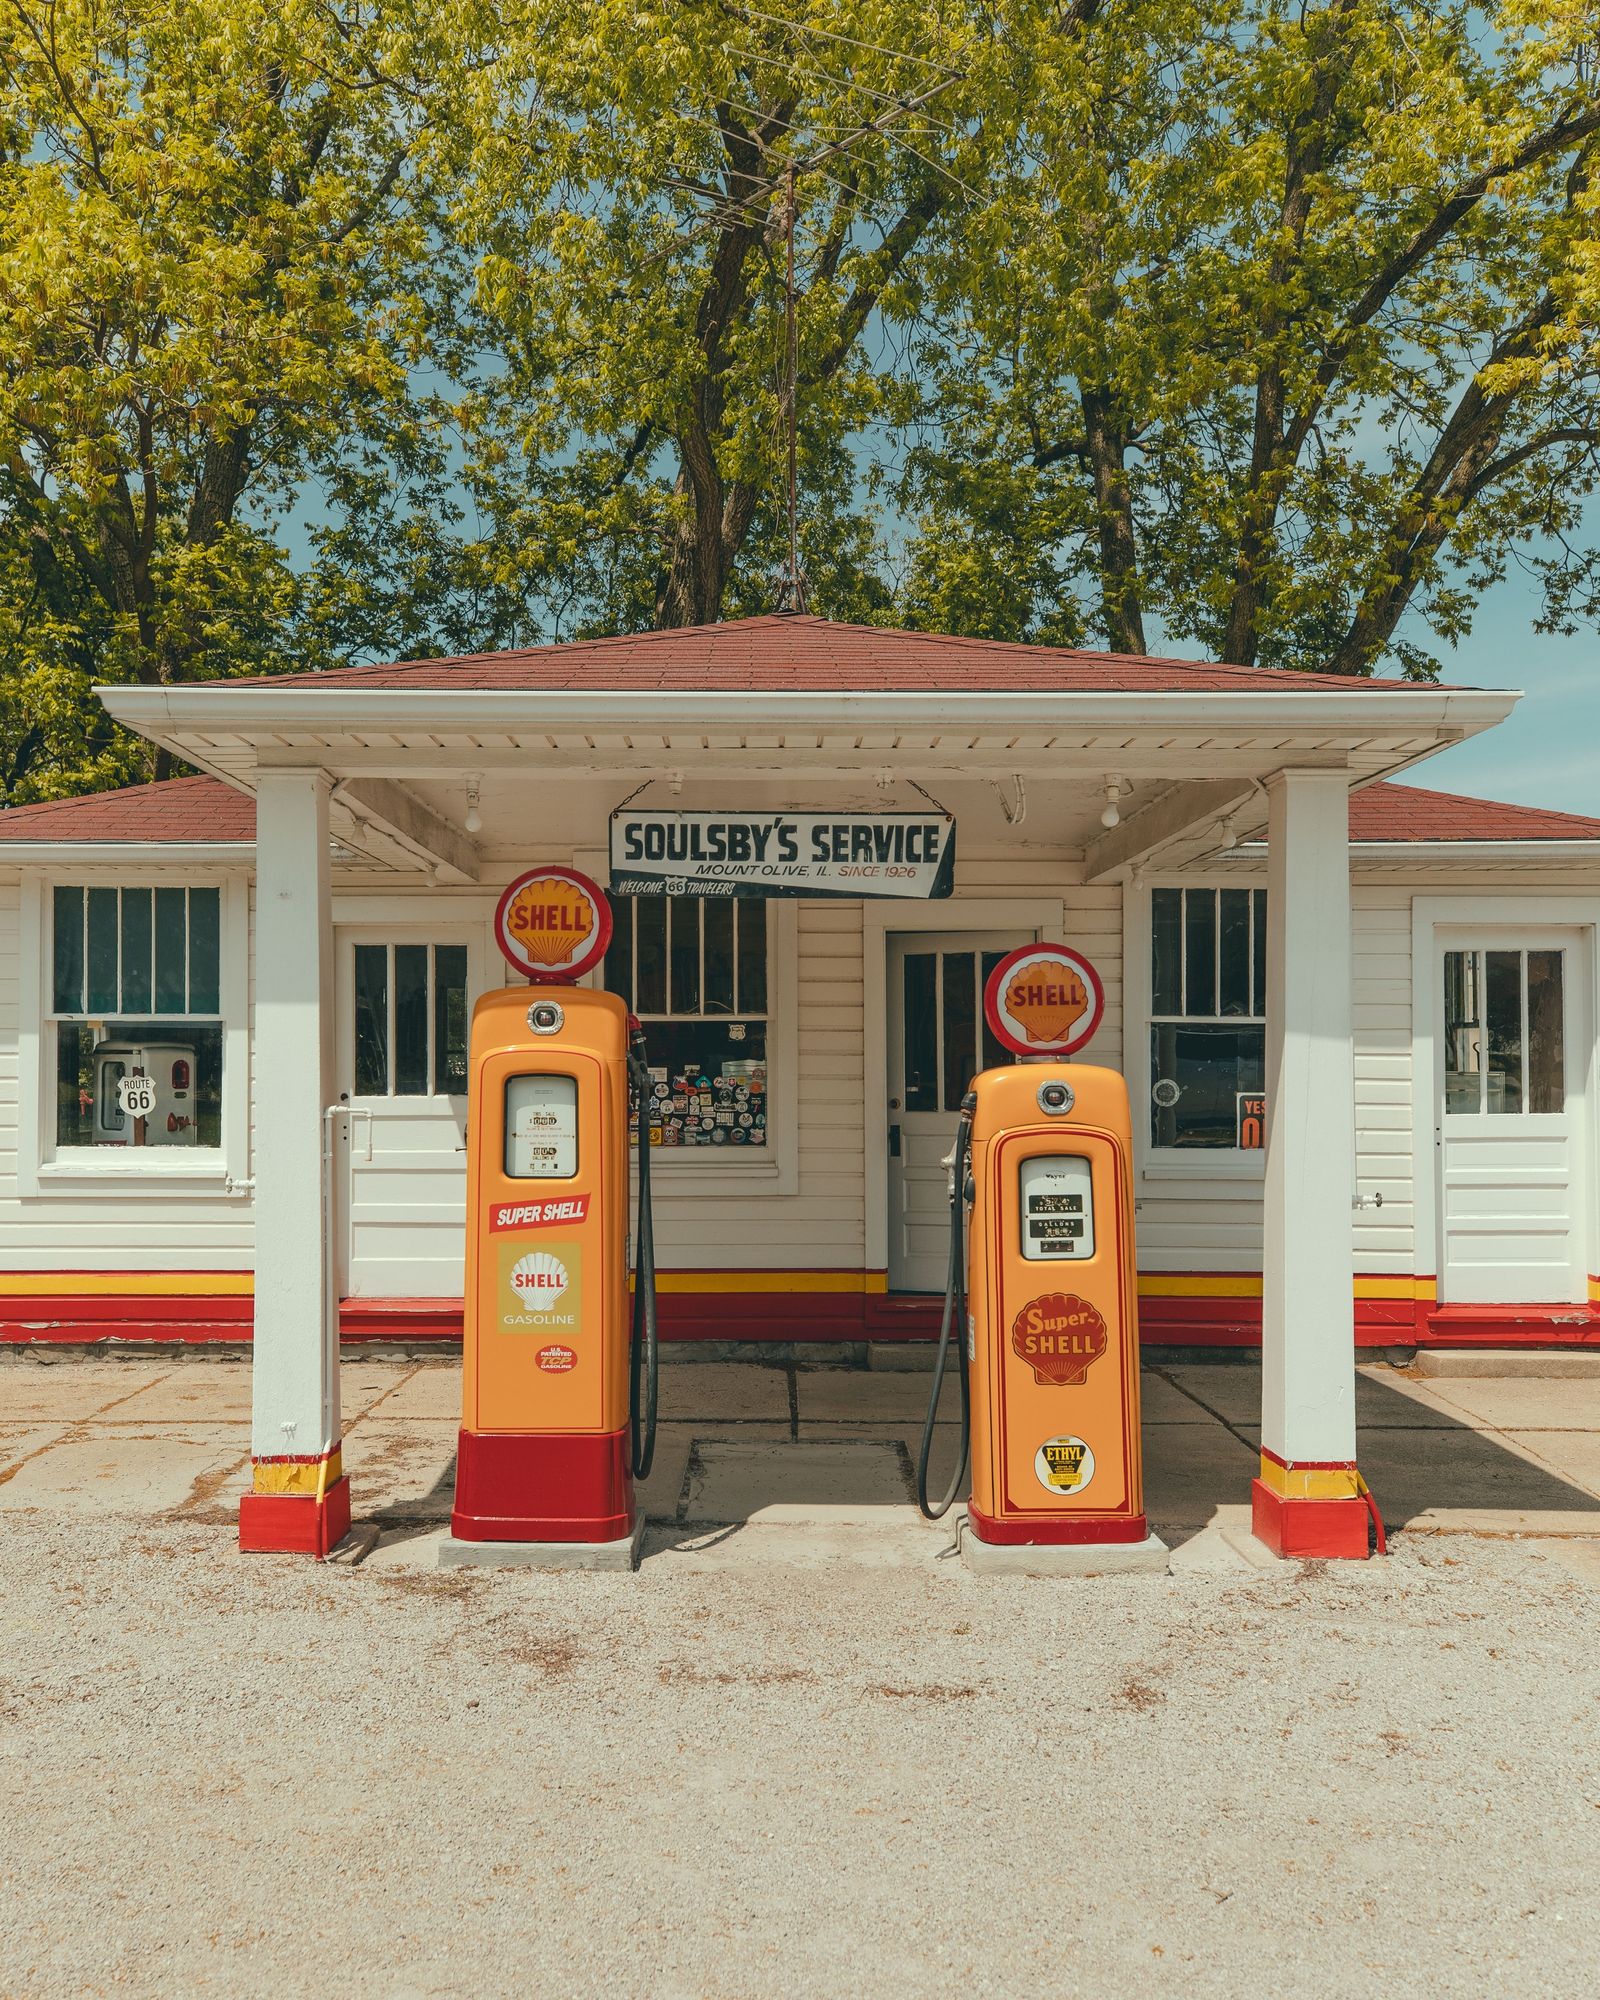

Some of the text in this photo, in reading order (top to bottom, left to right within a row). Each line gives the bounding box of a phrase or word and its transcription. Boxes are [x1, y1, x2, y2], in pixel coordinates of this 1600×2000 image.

[625, 817, 939, 863] SOULSBY'S SERVICE
[695, 864, 917, 878] MOUNT OLIVE, IL. SINCE 1926
[619, 880, 736, 895] WELCOME 66 TRAVELERS
[513, 904, 587, 932] SHELL
[1013, 984, 1082, 1008] SHELL
[124, 1079, 150, 1089] ROUTE
[127, 1091, 150, 1110] 66
[497, 1201, 584, 1226] SUPER SHELL
[515, 1273, 564, 1288] SHELL
[503, 1314, 575, 1325] GASOLINE
[1025, 1335, 1096, 1354] SHELL
[540, 1357, 572, 1365] TCP
[1046, 1446, 1083, 1461] ETHYL
